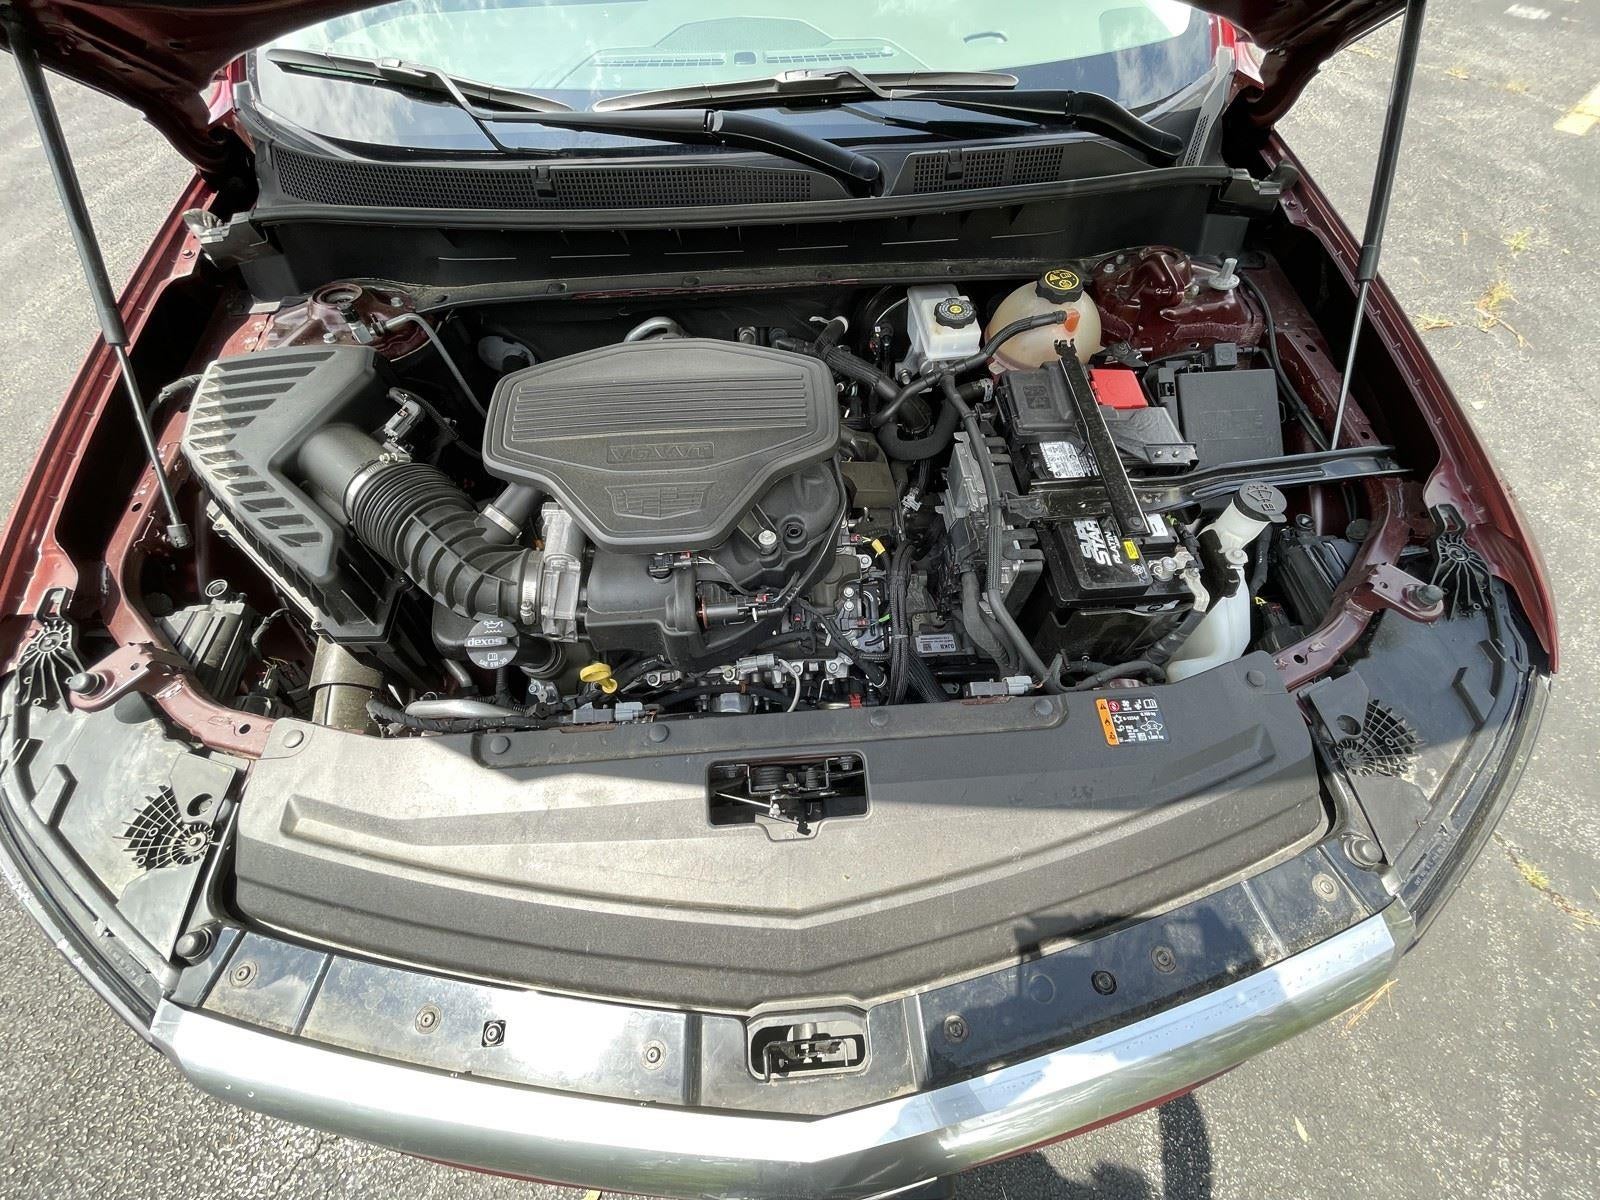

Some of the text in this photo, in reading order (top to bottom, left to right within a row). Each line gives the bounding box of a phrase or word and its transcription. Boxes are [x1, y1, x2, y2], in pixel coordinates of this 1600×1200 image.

[1084, 519, 1113, 566] STAR
[1105, 531, 1123, 565] PLATIN
[467, 637, 503, 647] dexos
